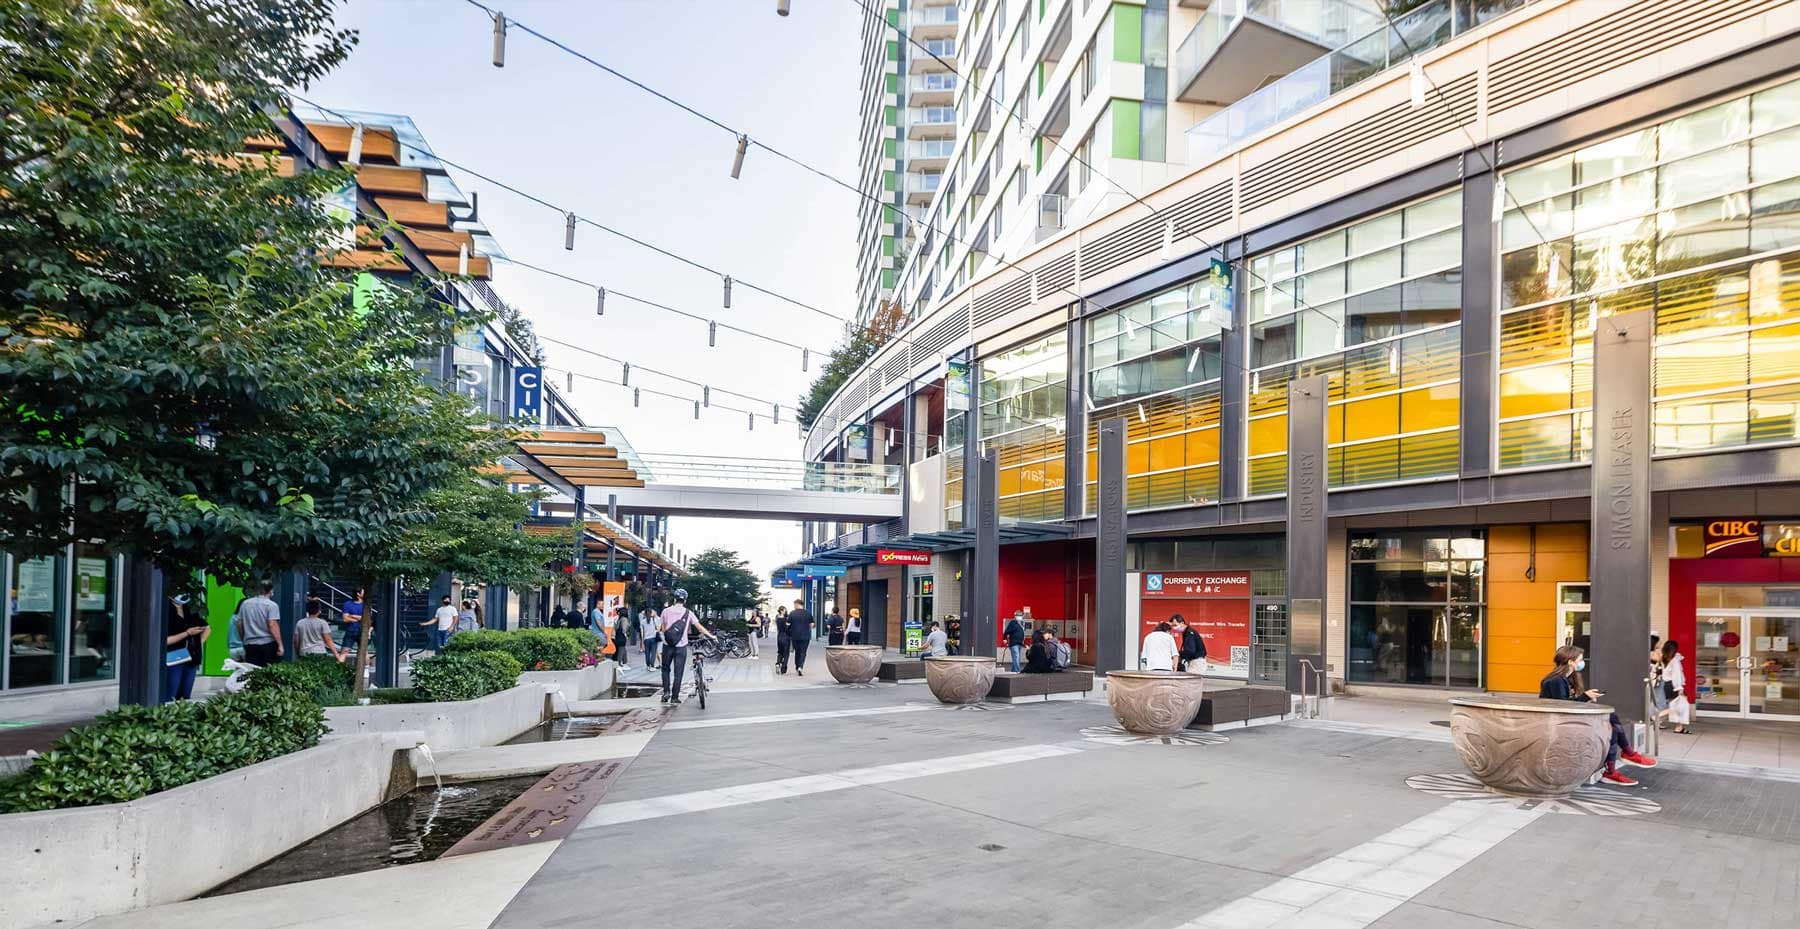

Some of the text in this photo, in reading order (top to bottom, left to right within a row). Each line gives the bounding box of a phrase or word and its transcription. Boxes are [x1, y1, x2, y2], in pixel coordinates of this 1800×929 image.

[1298, 453, 1315, 523] INDUSTRY
[1611, 483, 1633, 551] SIMON
[1708, 521, 1758, 536] CIBC
[1775, 537, 1800, 553] CI
[912, 554, 929, 562] News
[1163, 576, 1248, 585] CURRENCY EXCHANGE
